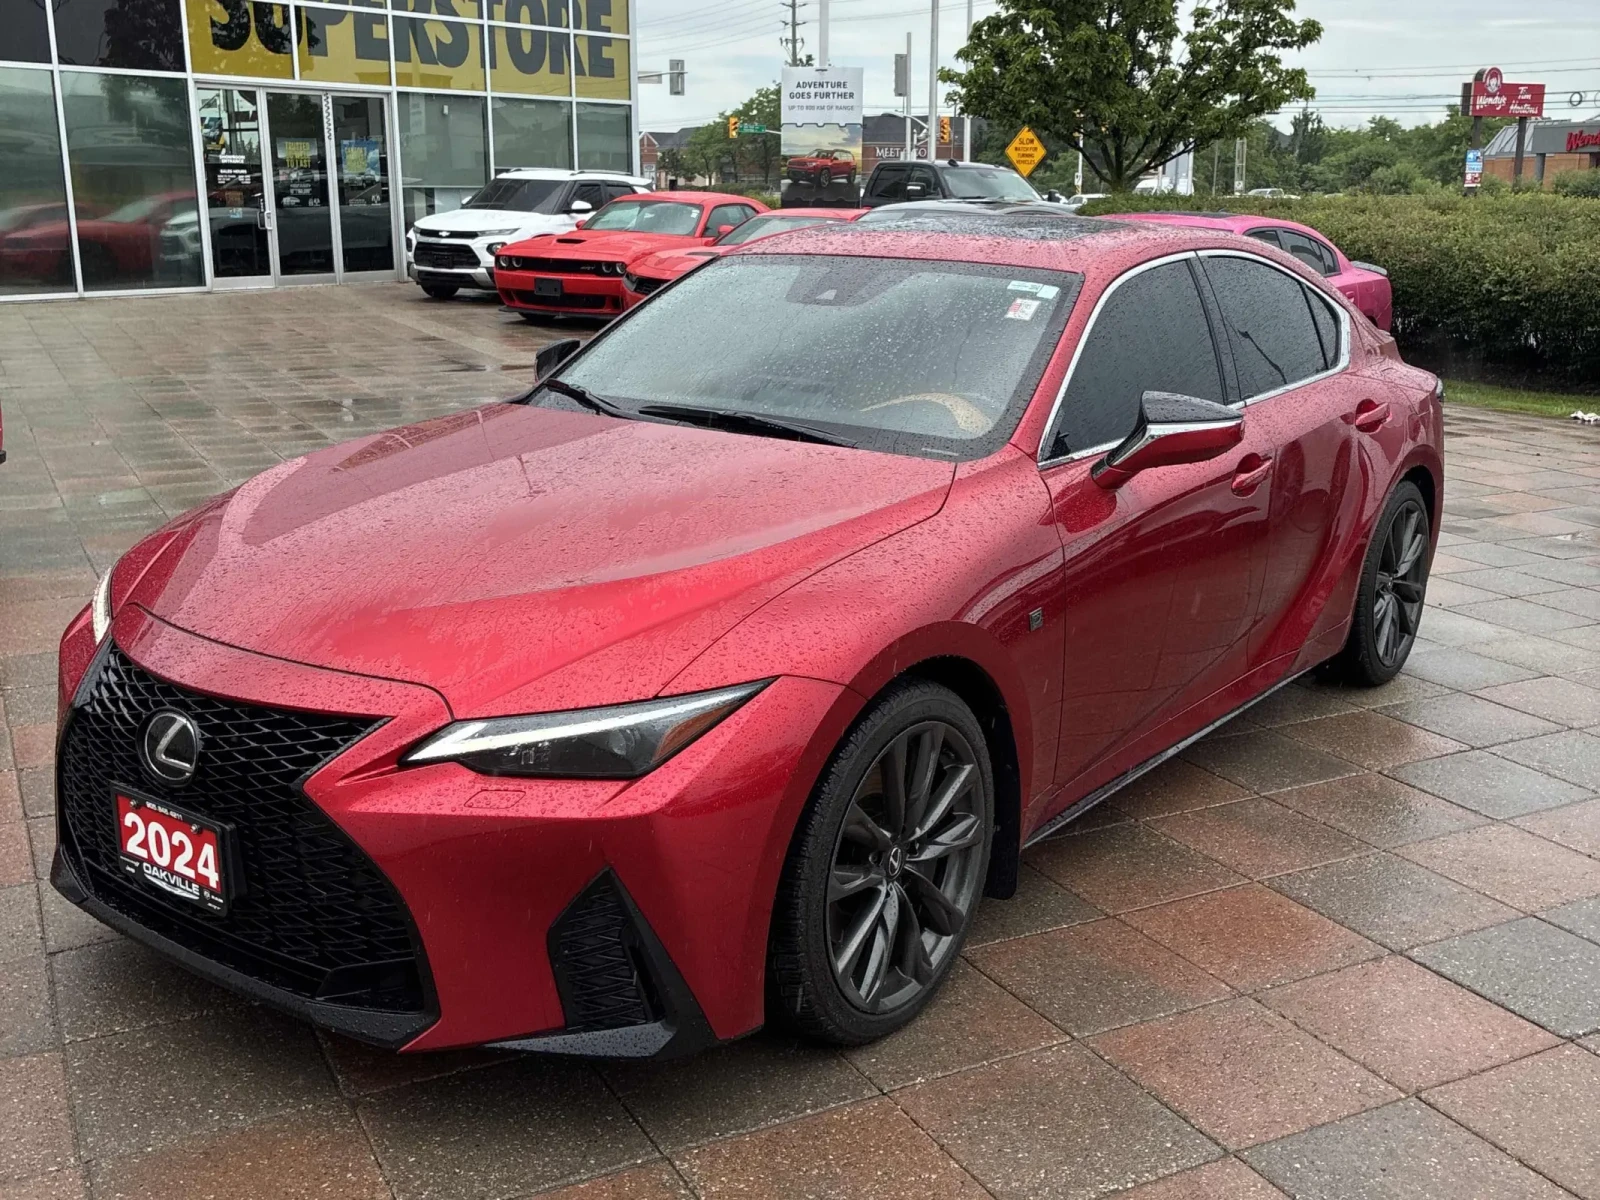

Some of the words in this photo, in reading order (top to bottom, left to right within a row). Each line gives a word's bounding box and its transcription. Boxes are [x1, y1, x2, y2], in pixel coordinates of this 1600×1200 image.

[210, 0, 615, 78] SUPERSTORE
[796, 81, 848, 89] ADVENTURE
[875, 147, 901, 158] MEET
[124, 812, 219, 888] 2024
[143, 862, 200, 895] OAKVILLE
